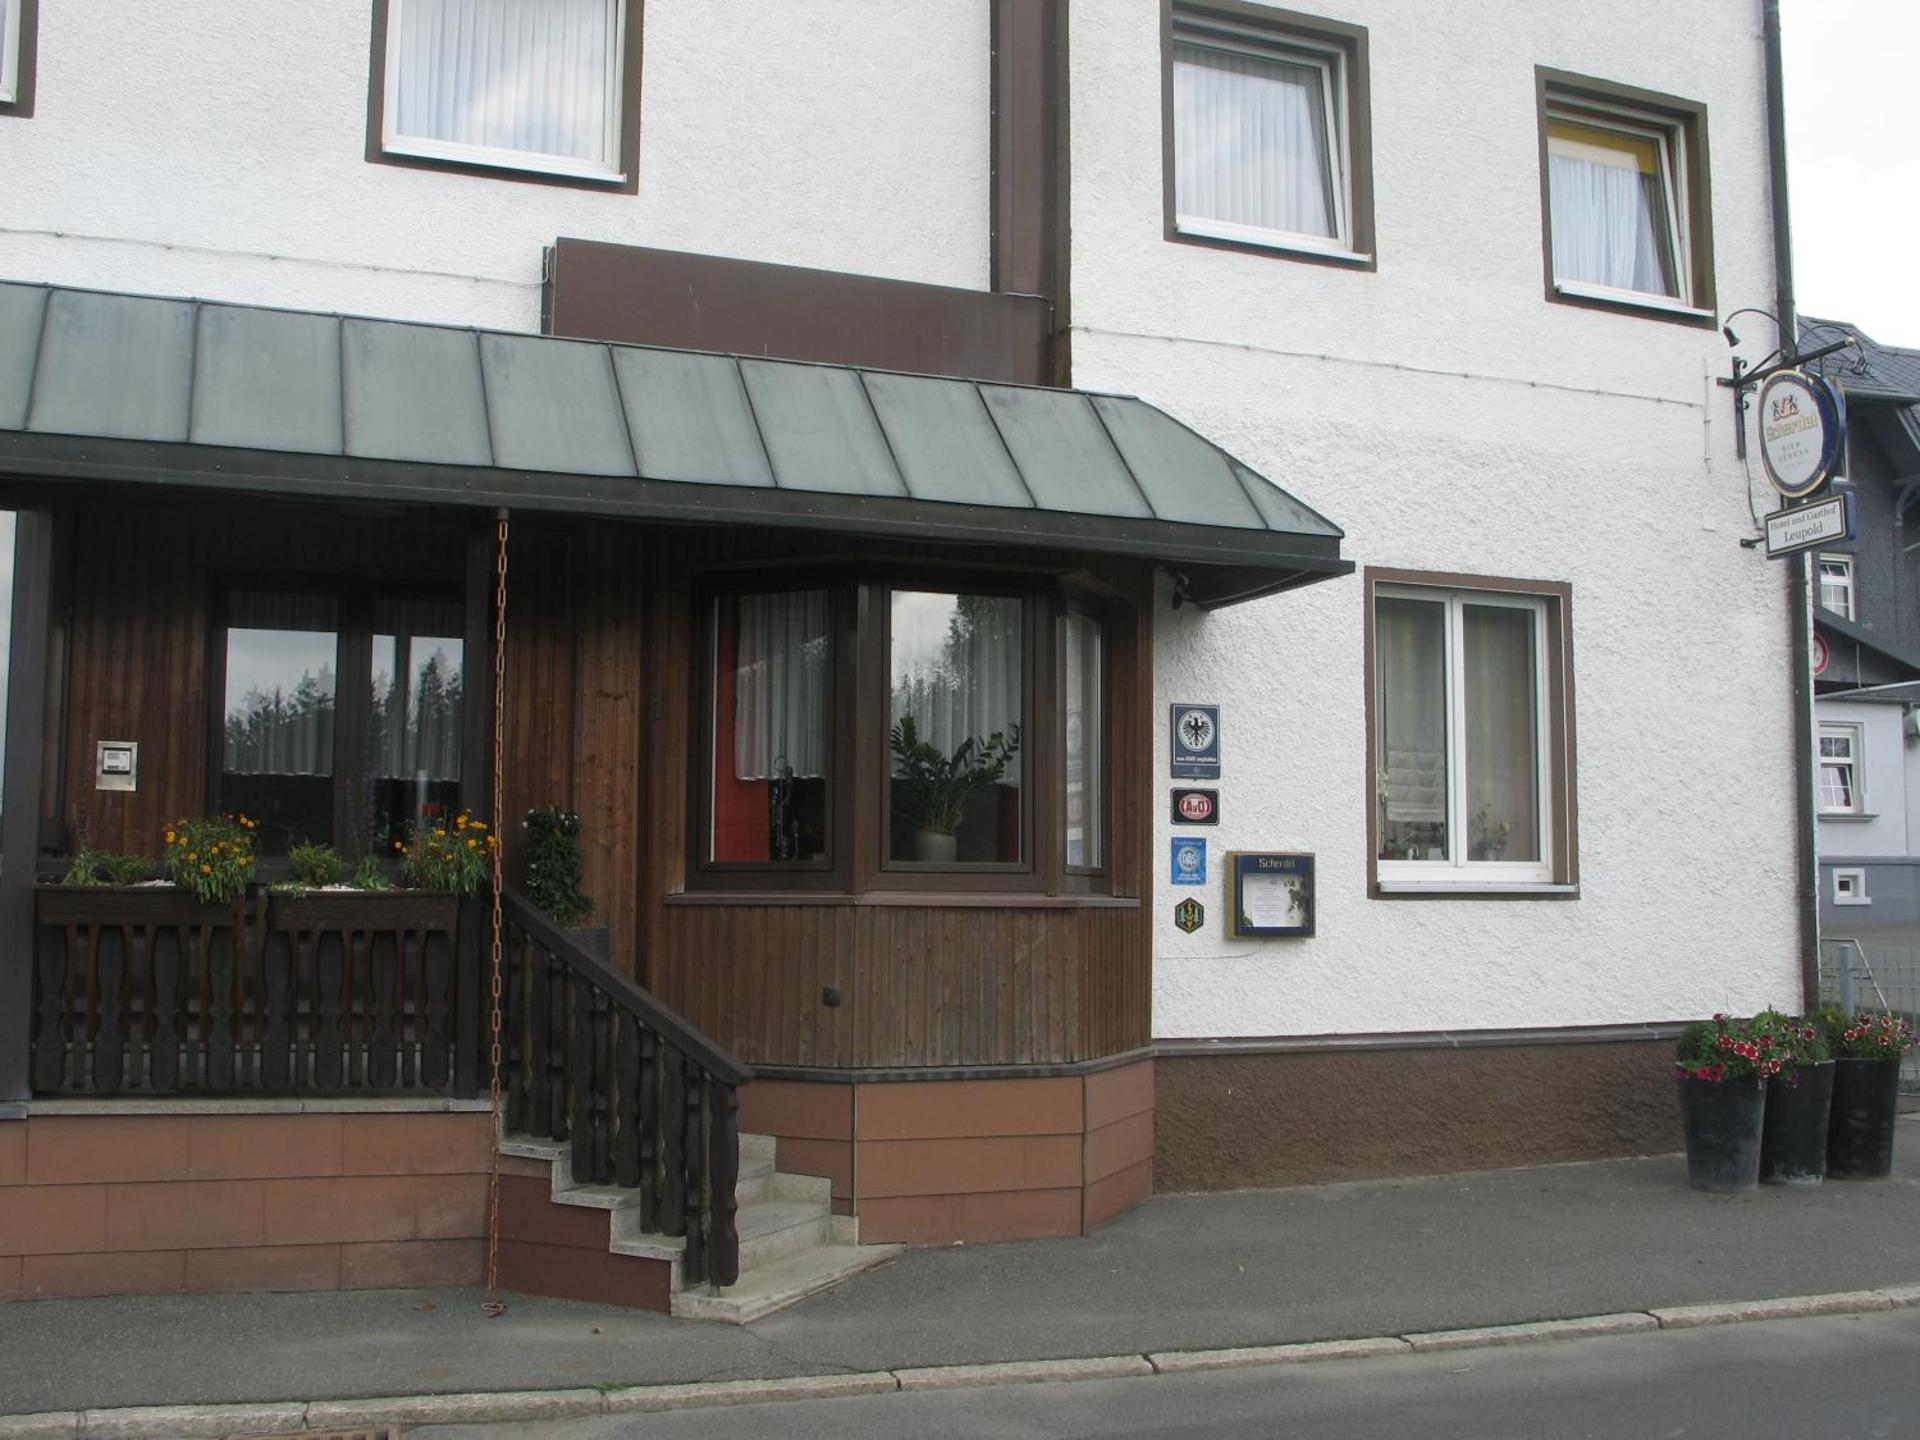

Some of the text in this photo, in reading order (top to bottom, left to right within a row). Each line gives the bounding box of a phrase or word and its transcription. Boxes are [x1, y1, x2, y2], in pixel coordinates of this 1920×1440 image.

[1770, 504, 1837, 531] Hotel und Gasthof
[1784, 520, 1823, 542] Leupold
